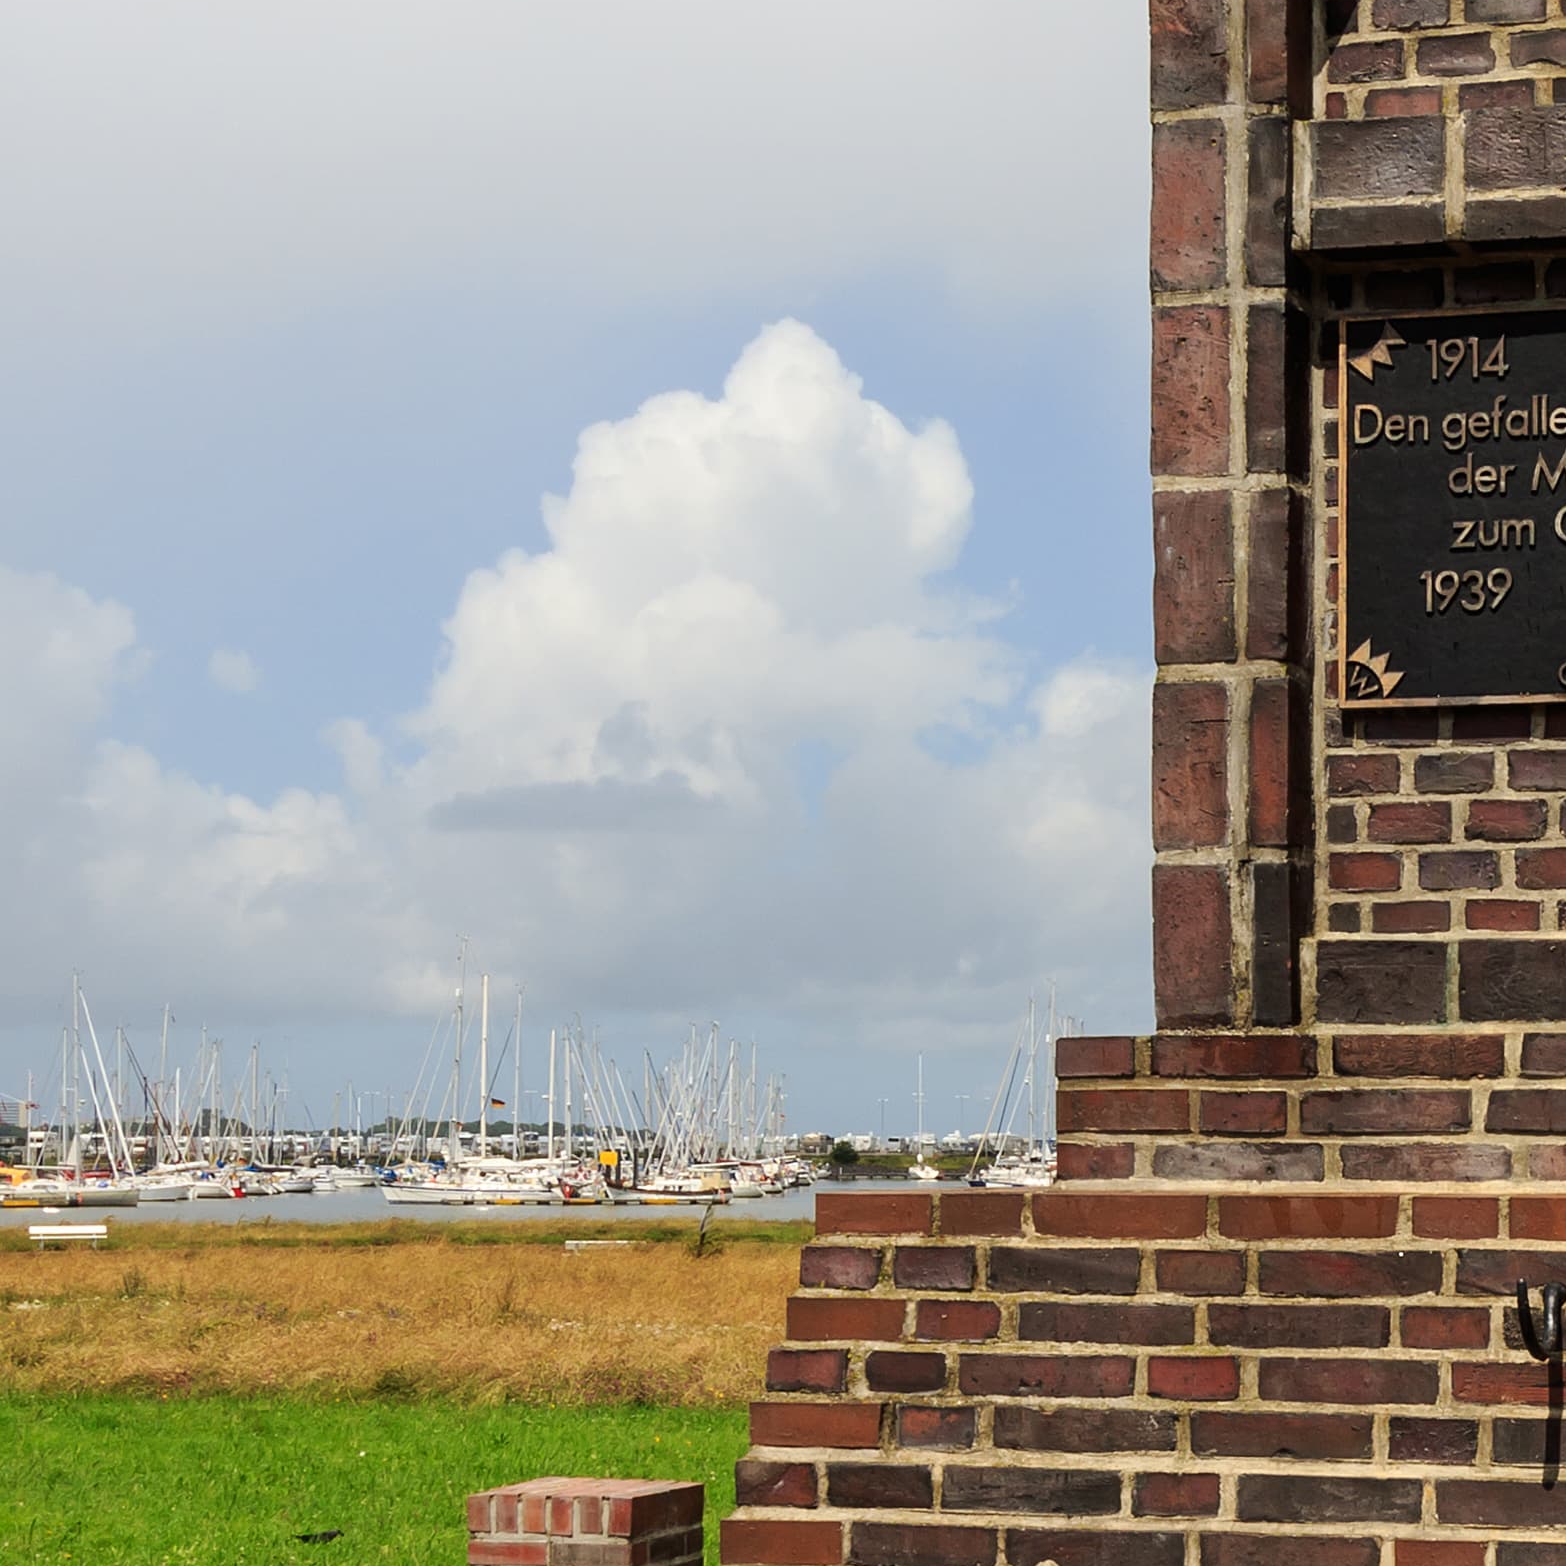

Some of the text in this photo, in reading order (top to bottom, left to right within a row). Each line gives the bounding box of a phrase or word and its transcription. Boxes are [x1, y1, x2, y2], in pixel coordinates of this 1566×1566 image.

[1426, 334, 1510, 380] 1914
[1353, 403, 1429, 444] Den
[1448, 452, 1516, 494] der
[1451, 518, 1535, 548] zum
[1419, 567, 1513, 612] 1939
